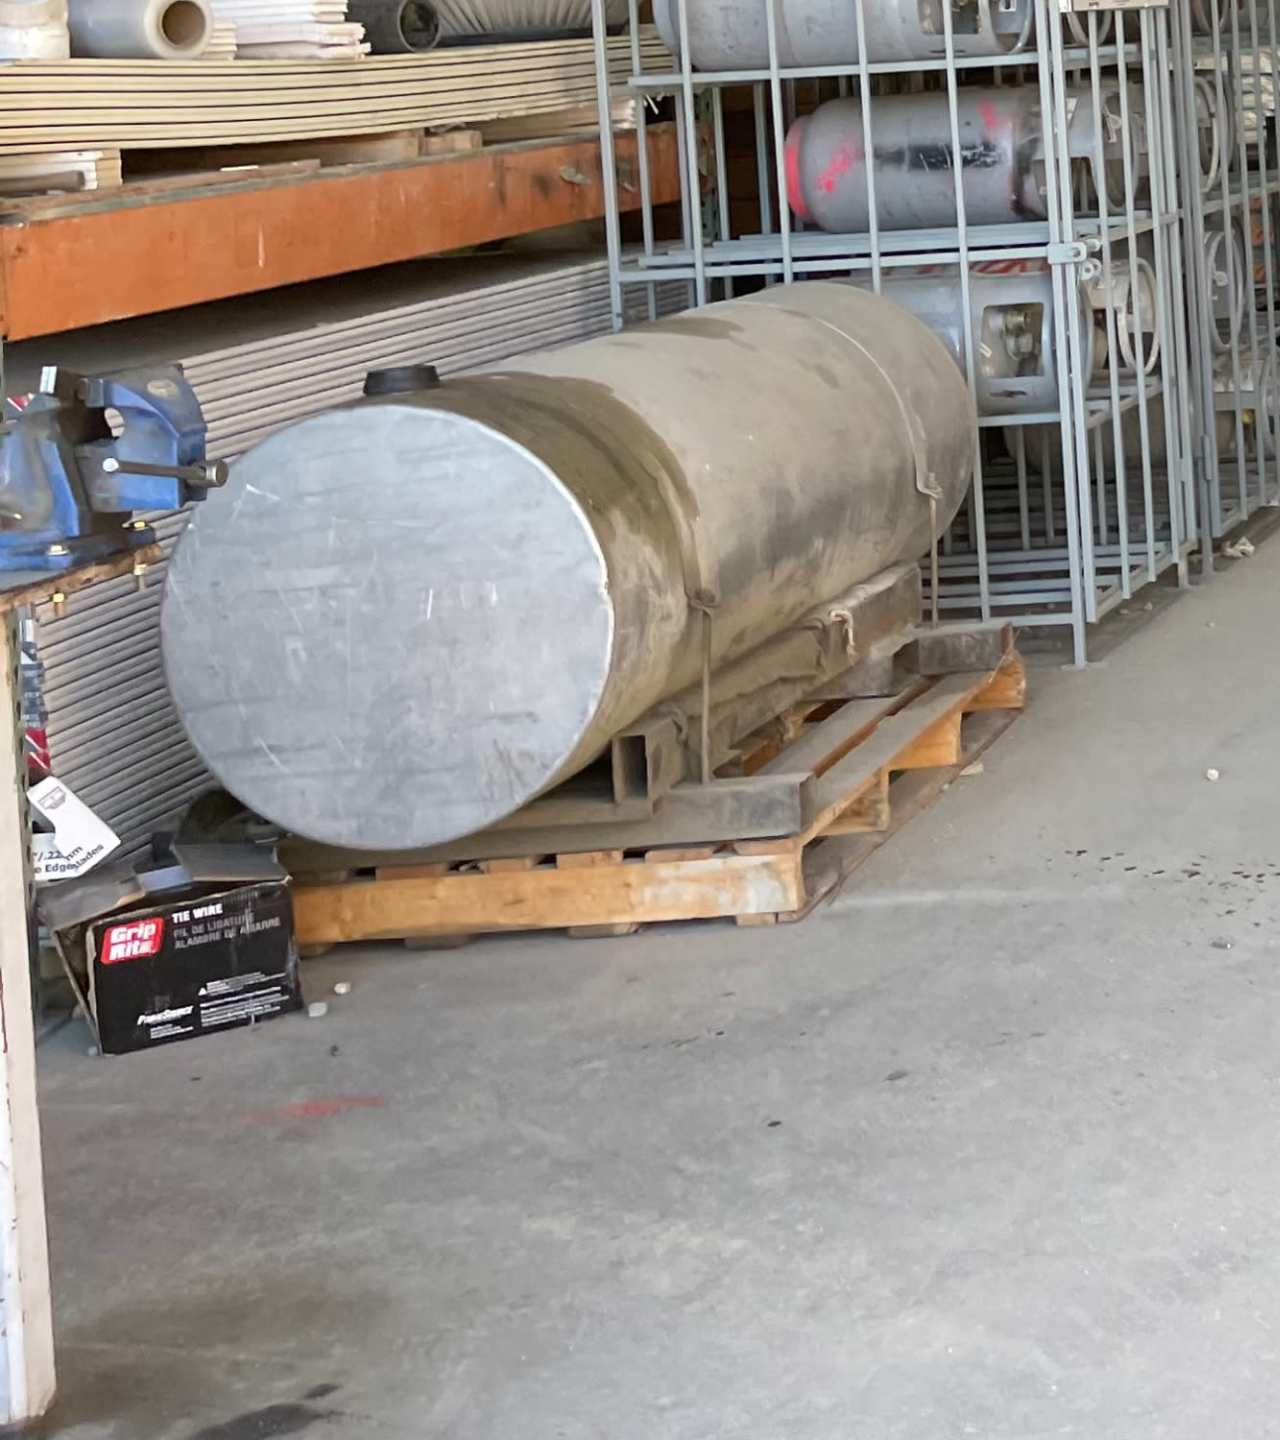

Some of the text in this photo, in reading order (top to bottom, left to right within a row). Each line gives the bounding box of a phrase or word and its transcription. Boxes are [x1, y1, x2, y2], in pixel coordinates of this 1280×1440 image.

[172, 904, 223, 924] TIE WIRE
[110, 923, 156, 945] Grip
[173, 926, 189, 938] FIL
[191, 923, 206, 935] DE
[174, 931, 223, 950] ALAMBRE
[224, 927, 237, 939] DE
[109, 941, 156, 962] Rite
